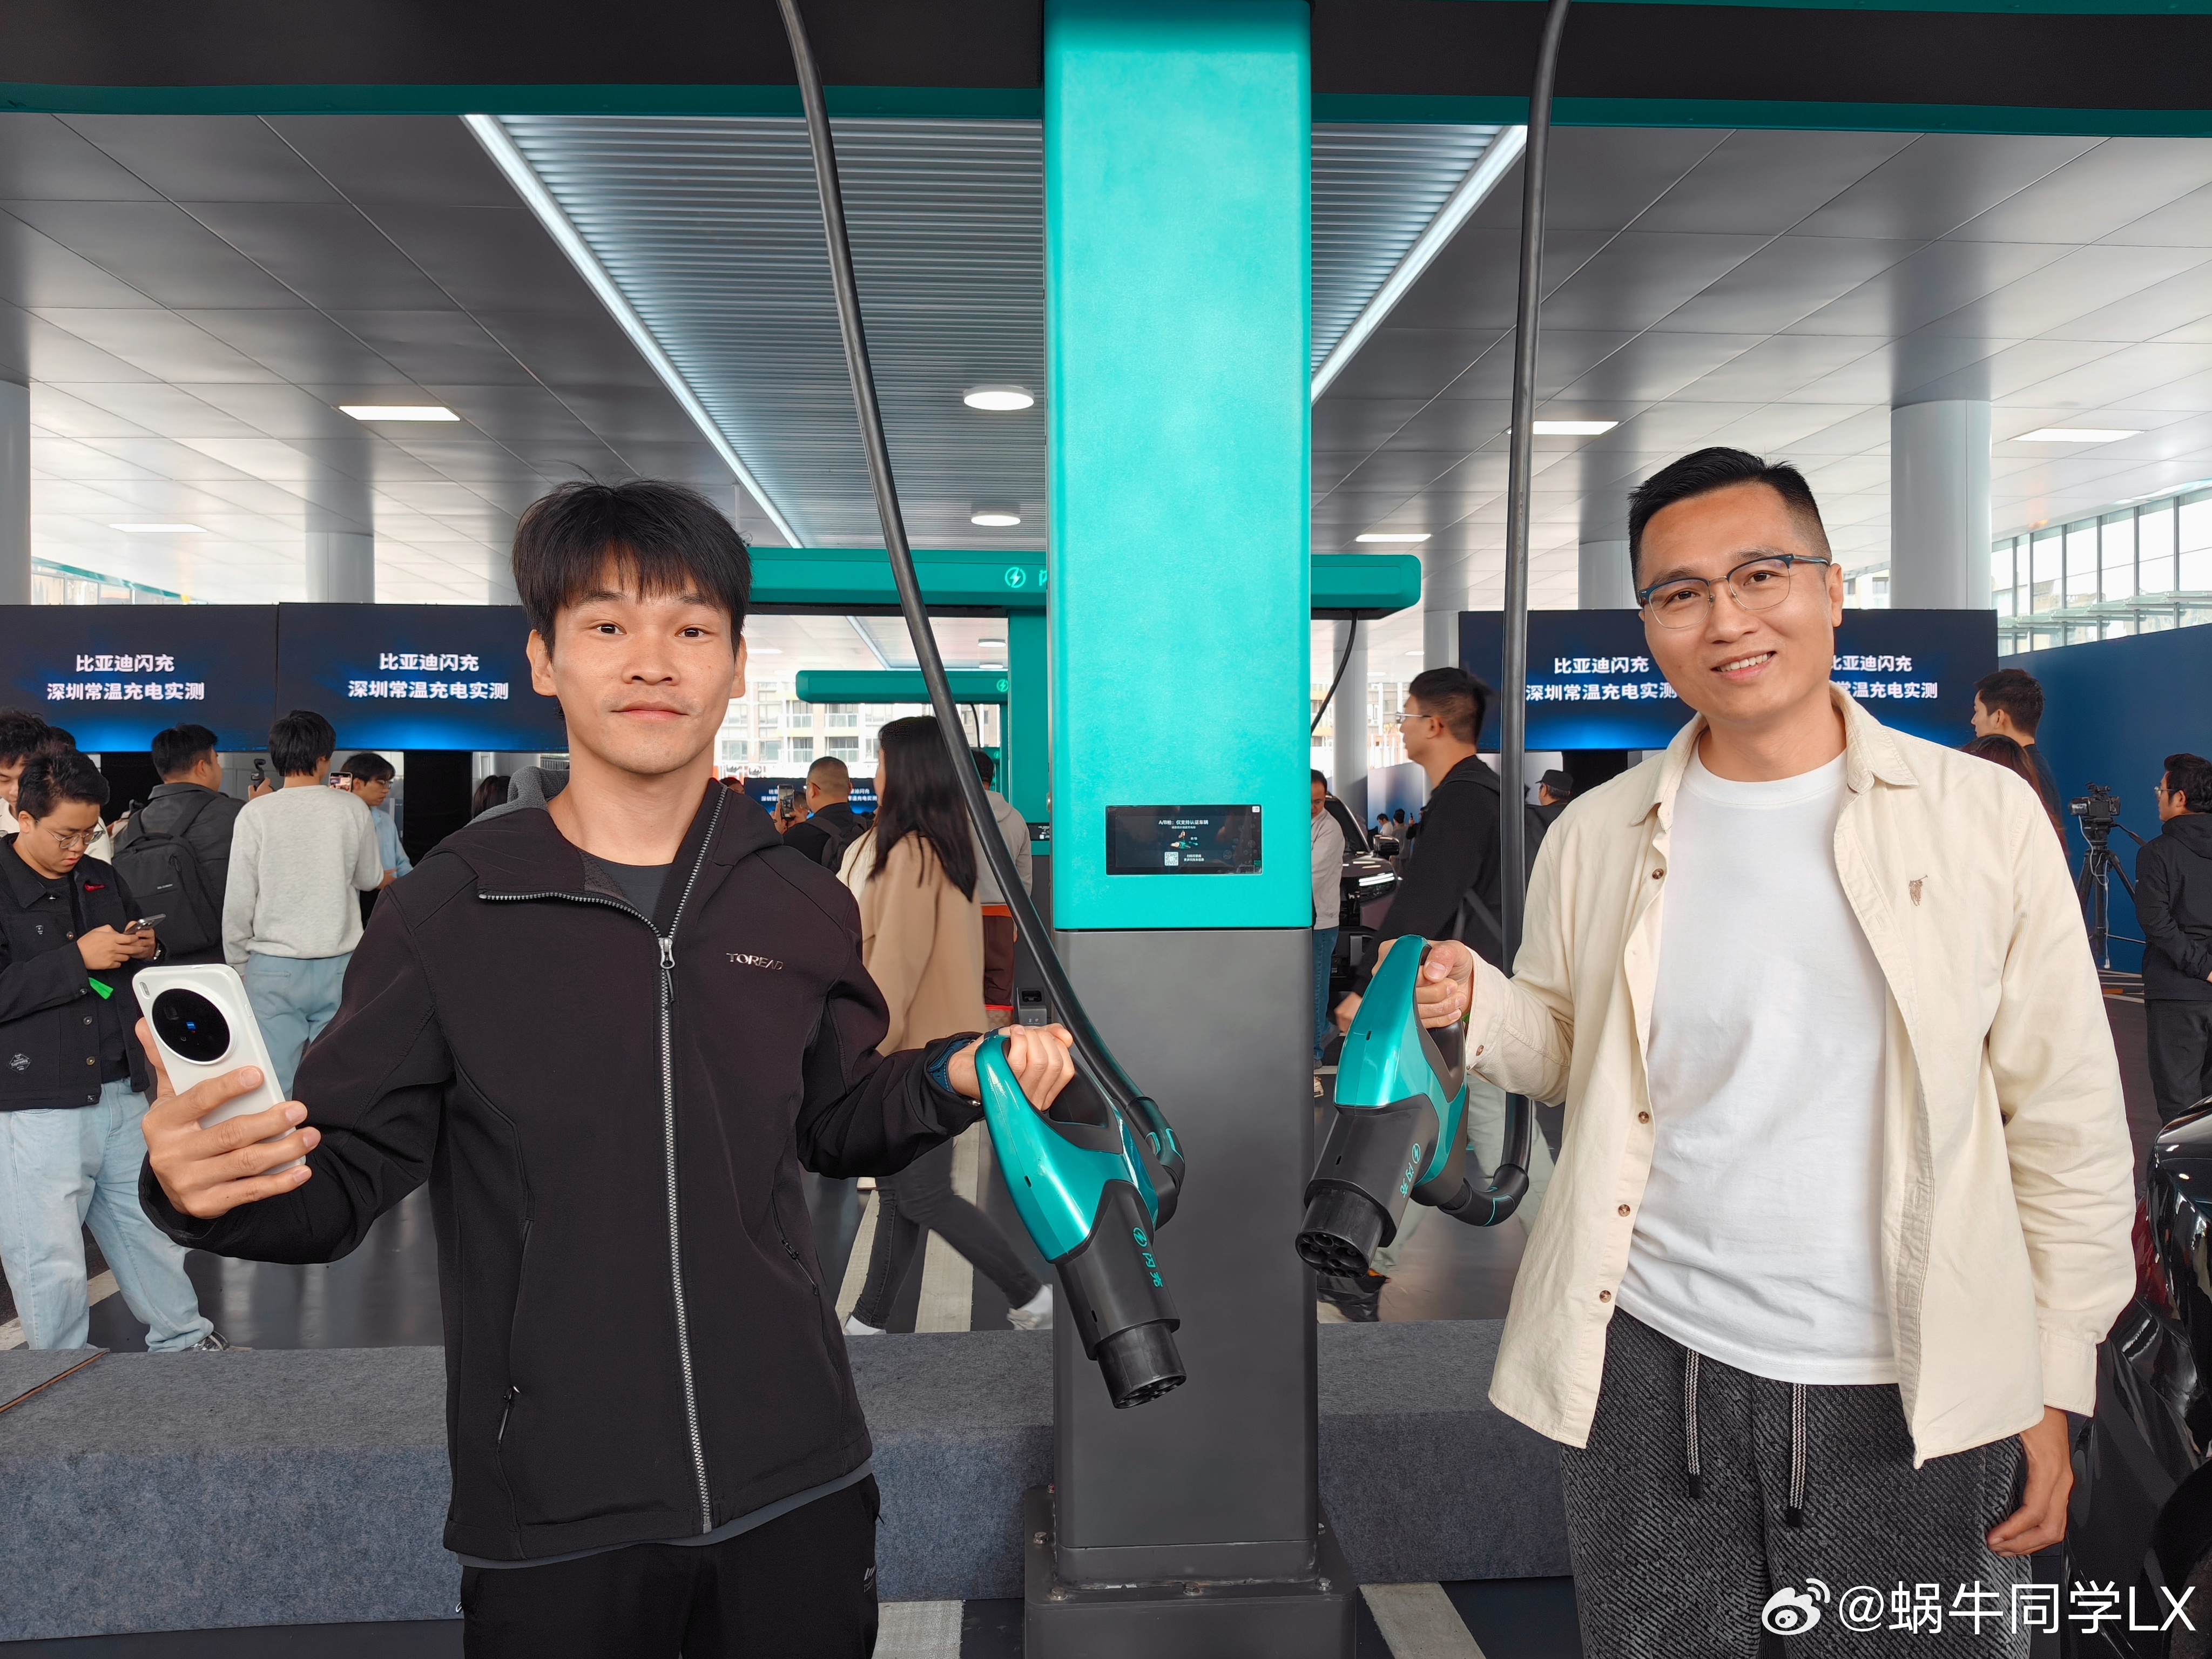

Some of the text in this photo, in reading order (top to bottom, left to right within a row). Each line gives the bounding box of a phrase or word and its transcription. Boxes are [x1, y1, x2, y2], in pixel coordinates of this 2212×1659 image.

[76, 654, 174, 672] 比亚迪闪充
[379, 653, 479, 671] 比亚迪闪充
[1554, 656, 1649, 674] 比亚迪闪充
[47, 683, 205, 700] 深圳常温充电实测
[348, 680, 509, 700] 深圳常温充电实测
[1526, 682, 1677, 701] 深圳常温充电实测
[1837, 681, 1938, 699] 常温充电实测
[726, 953, 784, 970] TOREAD
[1400, 1162, 1414, 1198] 闪充
[1142, 1252, 1163, 1287] 闪充
